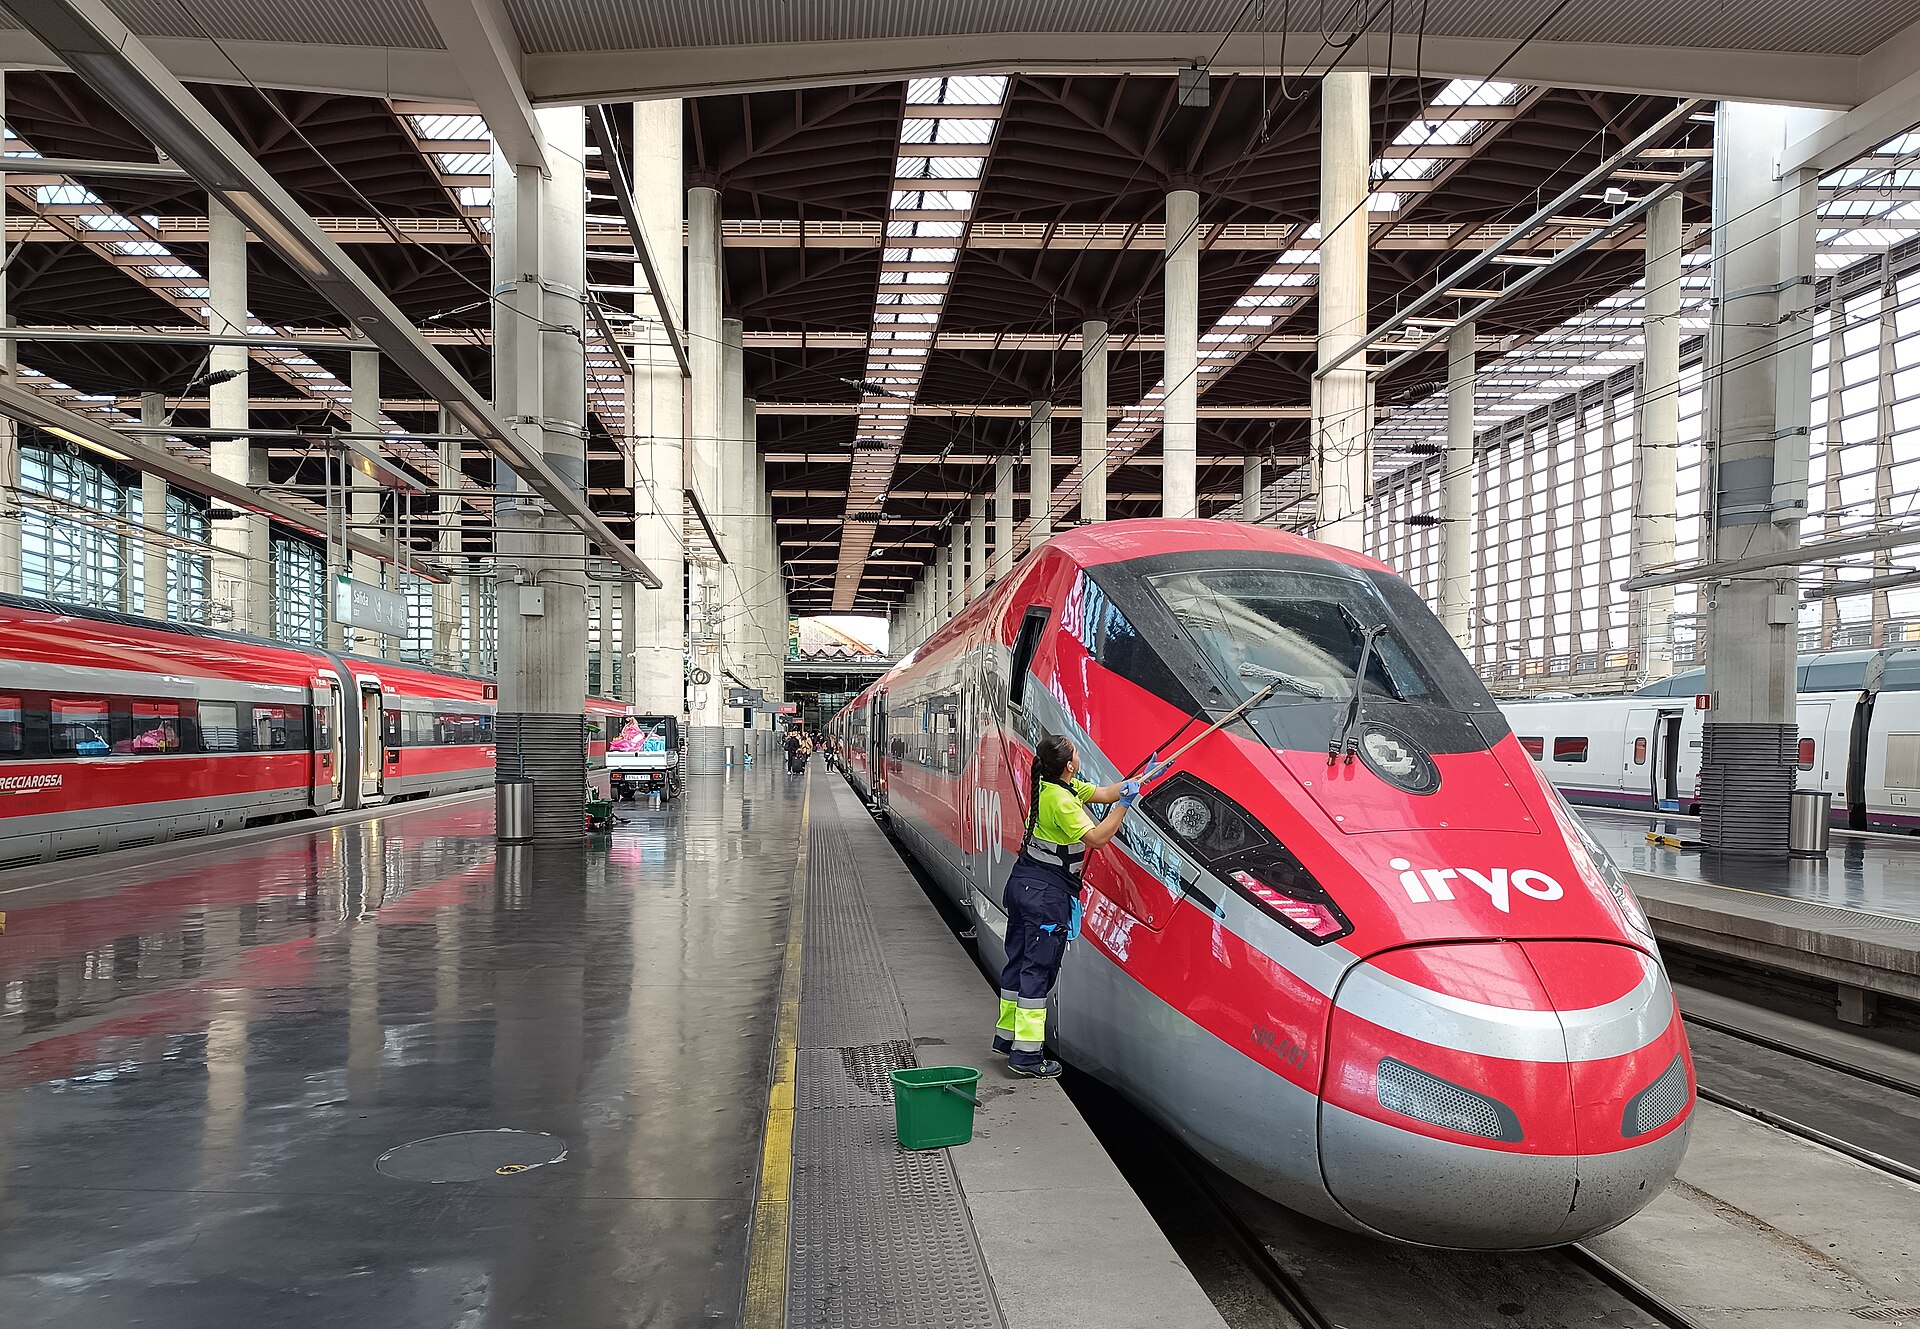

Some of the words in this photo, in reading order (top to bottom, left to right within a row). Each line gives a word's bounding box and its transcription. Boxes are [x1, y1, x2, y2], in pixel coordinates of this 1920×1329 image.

[353, 589, 369, 606] Salida
[974, 754, 1002, 888] iryo
[1388, 857, 1564, 913] iryo
[1250, 1023, 1309, 1070] 109-002
